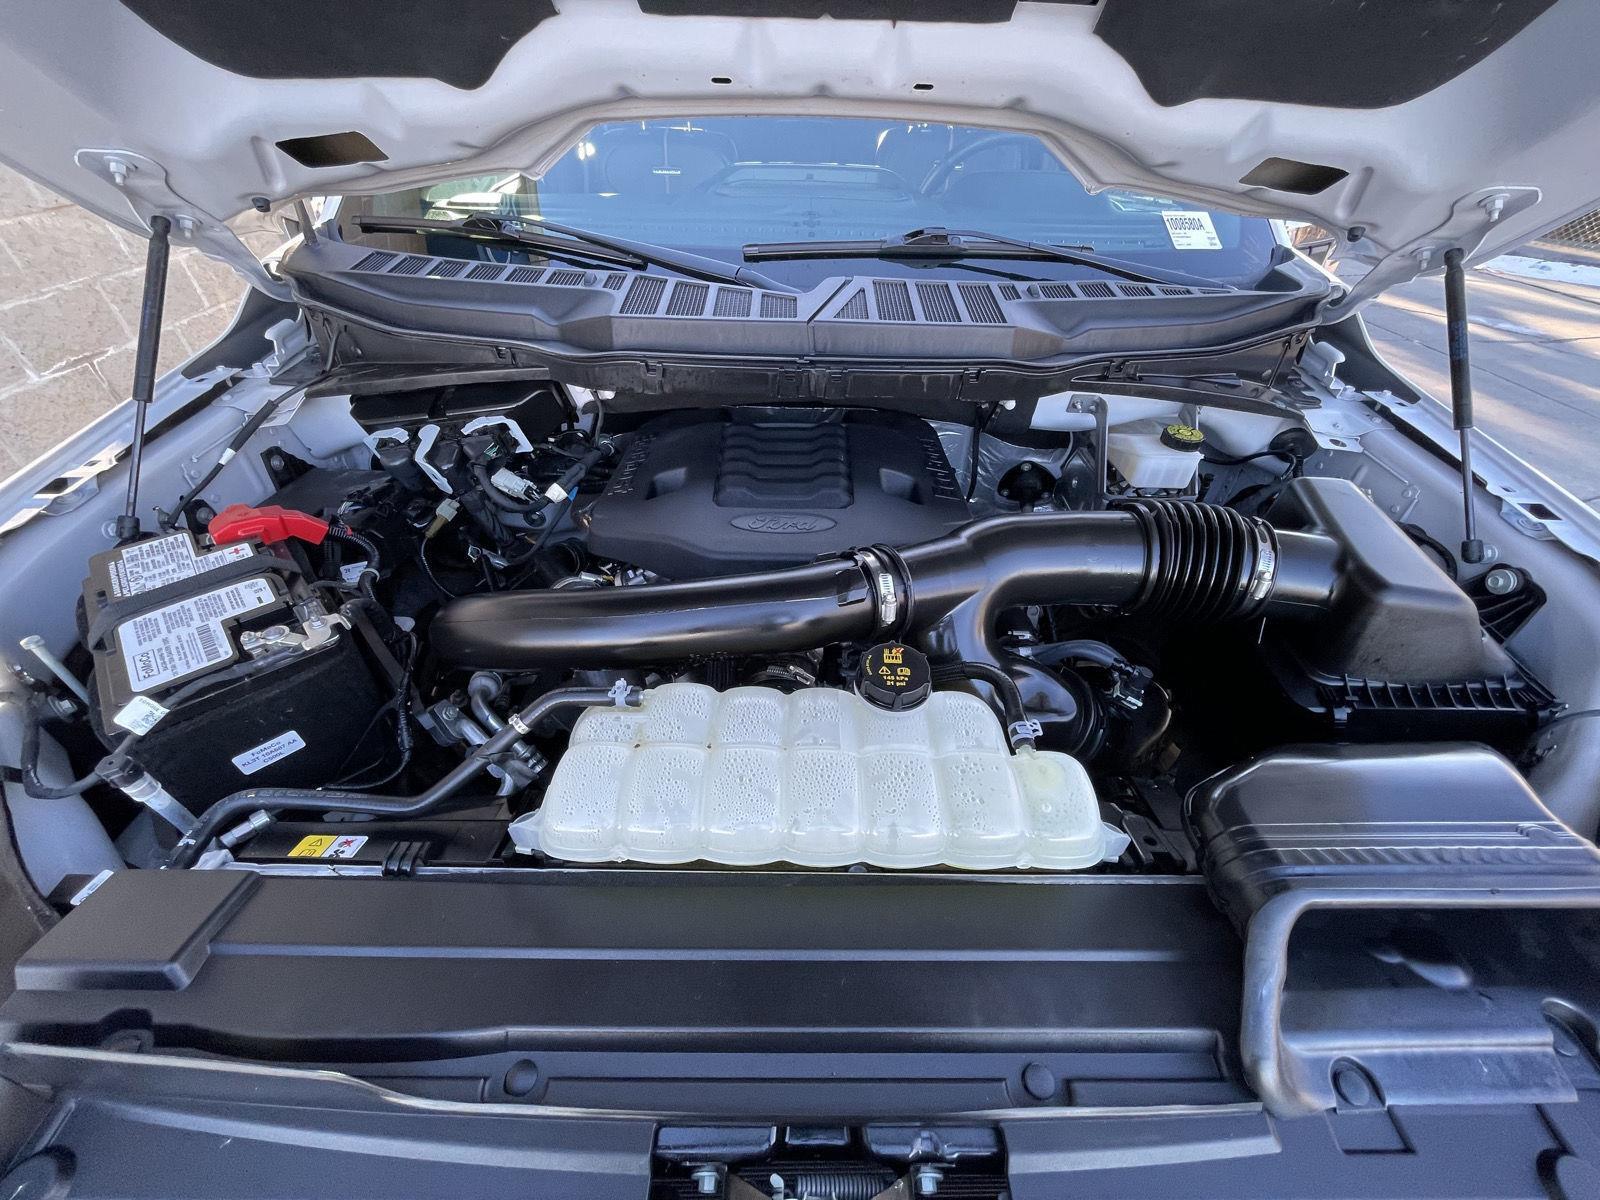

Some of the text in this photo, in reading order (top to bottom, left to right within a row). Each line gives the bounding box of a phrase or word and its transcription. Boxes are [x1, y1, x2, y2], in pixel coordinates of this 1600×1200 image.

[748, 515, 817, 531] Ford
[139, 652, 154, 679] FoMoCo
[251, 741, 281, 757] FoMoCo
